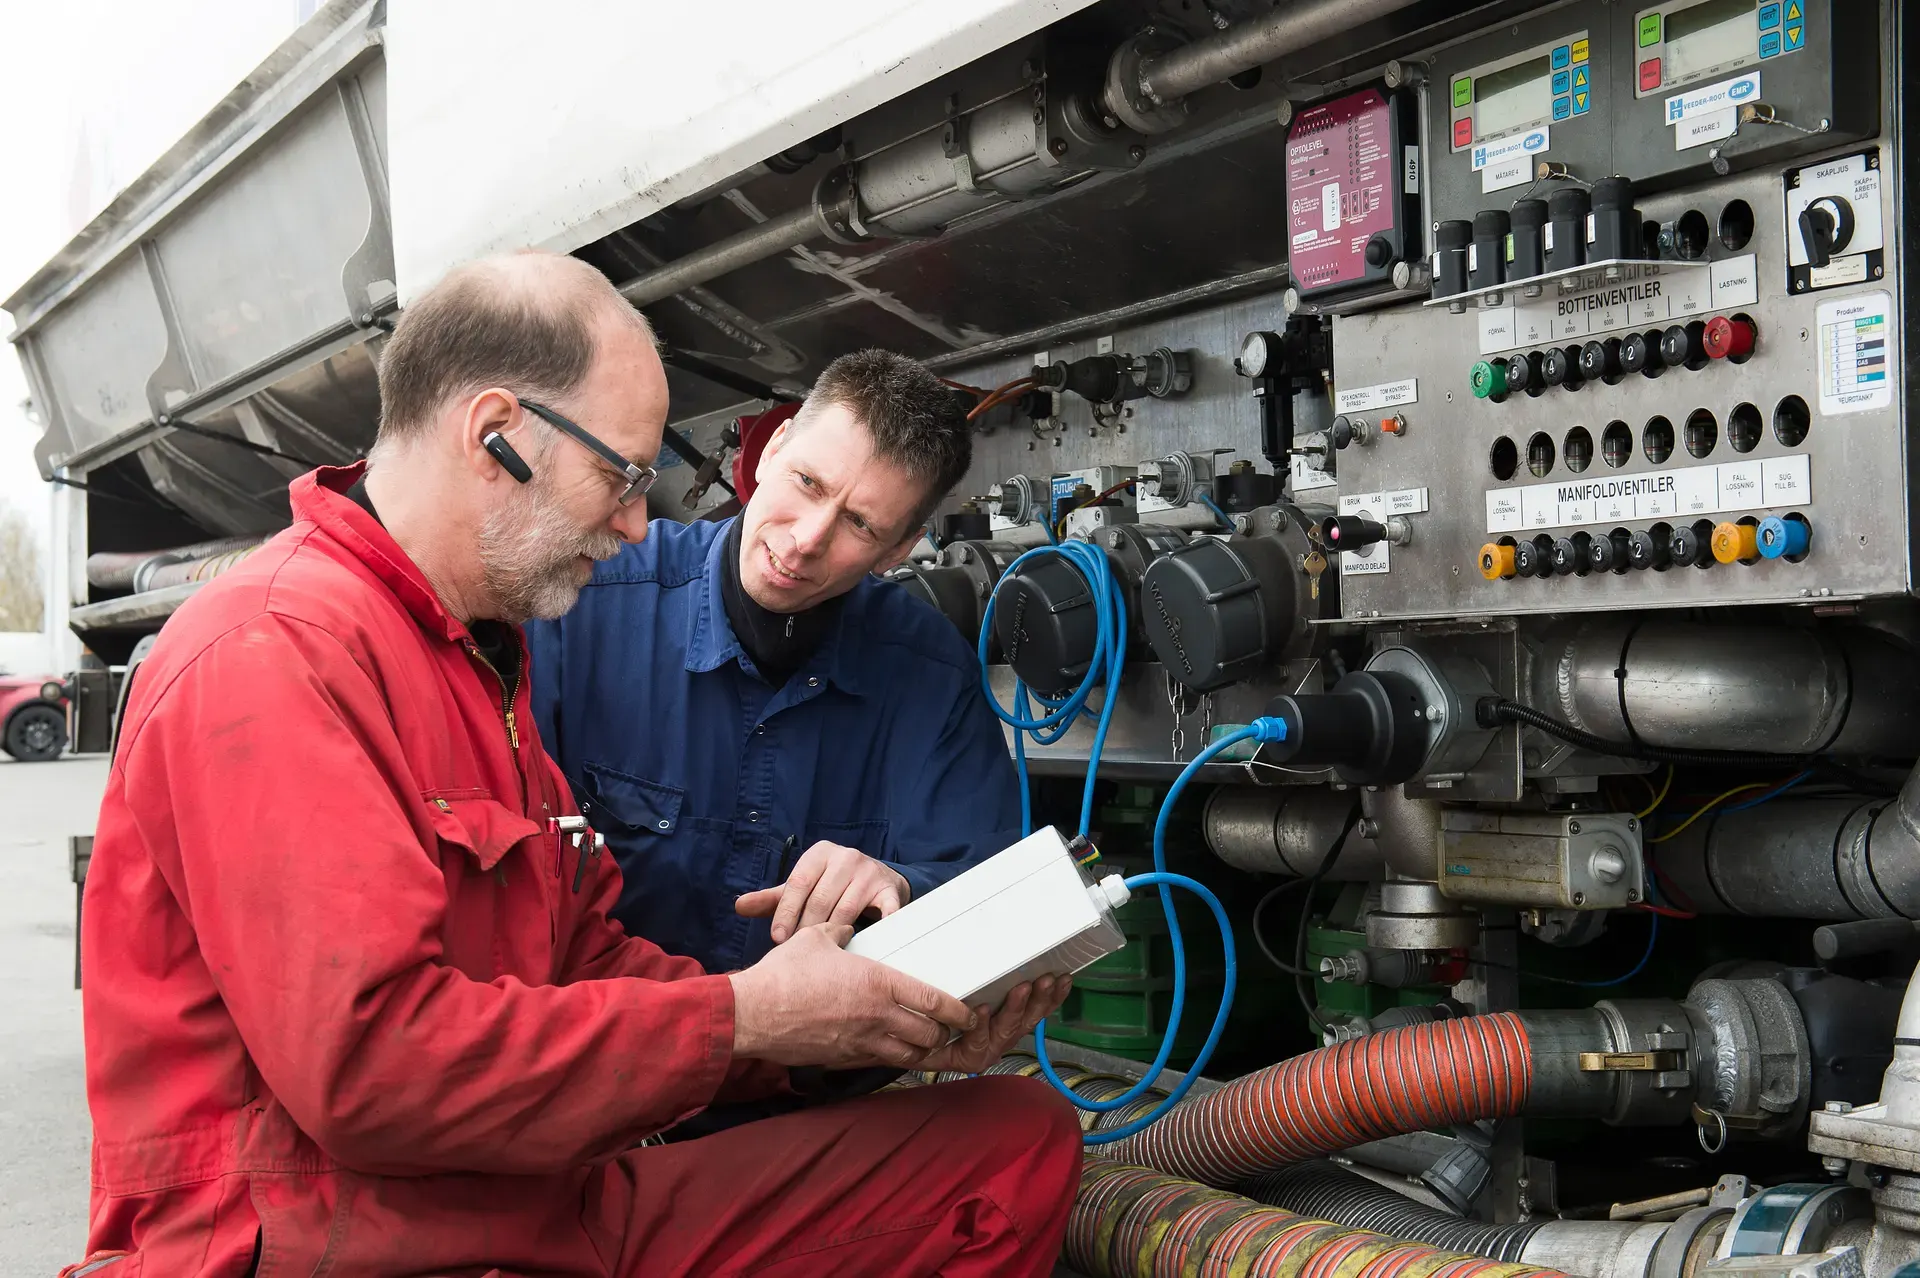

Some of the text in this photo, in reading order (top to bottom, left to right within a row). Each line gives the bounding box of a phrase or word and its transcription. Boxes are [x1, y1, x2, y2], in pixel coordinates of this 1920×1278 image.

[1573, 46, 1588, 56] PRESET
[1684, 92, 1726, 110] VEEDER-ROOT
[1290, 139, 1324, 157] OPTOLEVEL
[1486, 144, 1521, 158] VEEDER-ROOT
[1854, 182, 1877, 193] ARBETS
[1854, 192, 1869, 201] LJUS
[1719, 278, 1748, 288] LASTNING
[1558, 281, 1662, 316] BOTTENVENTILER
[1684, 302, 1696, 310] 10000
[1836, 306, 1865, 316] Produkter
[1670, 340, 1674, 352] 1
[1628, 346, 1634, 360] 2
[1586, 352, 1592, 368] 3
[1512, 366, 1518, 380] 5
[1550, 364, 1554, 374] 4
[1390, 384, 1410, 393] KONTROLL
[1350, 392, 1370, 400] KONTROLL
[1385, 394, 1402, 402] BYPASS
[1296, 460, 1301, 478] 1
[1558, 476, 1674, 503] MANIFOLDVENTILER
[1726, 482, 1754, 490] LOSSNING
[1140, 486, 1146, 501] 2
[1493, 506, 1516, 514] LOSSNING
[1596, 546, 1602, 561] 3
[1636, 543, 1642, 558] 2
[1679, 541, 1684, 555] 1
[1486, 558, 1492, 566] A
[1521, 554, 1527, 566] 5
[1557, 550, 1564, 564] 4
